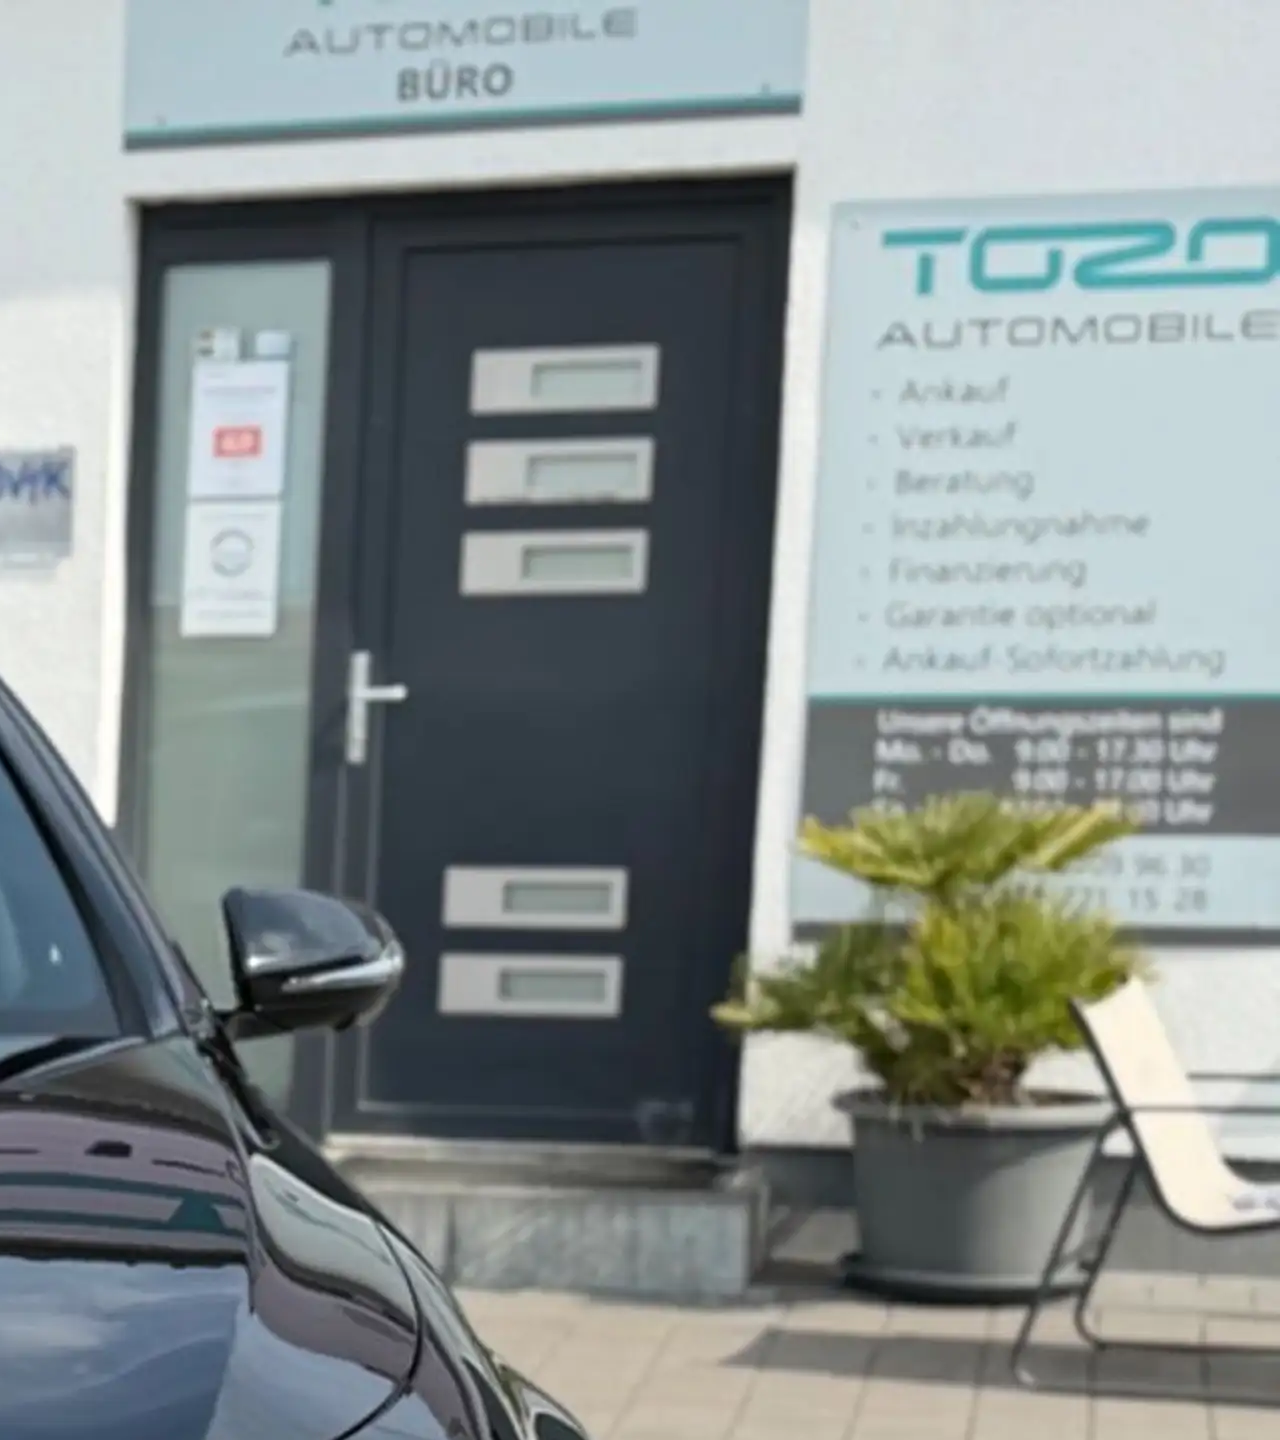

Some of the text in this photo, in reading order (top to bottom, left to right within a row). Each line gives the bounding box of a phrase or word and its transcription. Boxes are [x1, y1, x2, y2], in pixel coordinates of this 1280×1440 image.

[283, 6, 639, 57] AUTOMOBILE
[395, 58, 514, 101] BÜRO
[881, 216, 1280, 296] TOZO
[875, 309, 1280, 351] AUTOMOBILE
[898, 375, 1010, 403] Ankauf
[895, 420, 1017, 450] Verkauf
[894, 469, 1035, 501] Beratung
[892, 510, 1149, 544] Inzahlungnahme
[888, 557, 1088, 588] Finanzierung
[884, 598, 1158, 632] Garantie optional
[882, 642, 1227, 678] Ankauf Sofortzahlung
